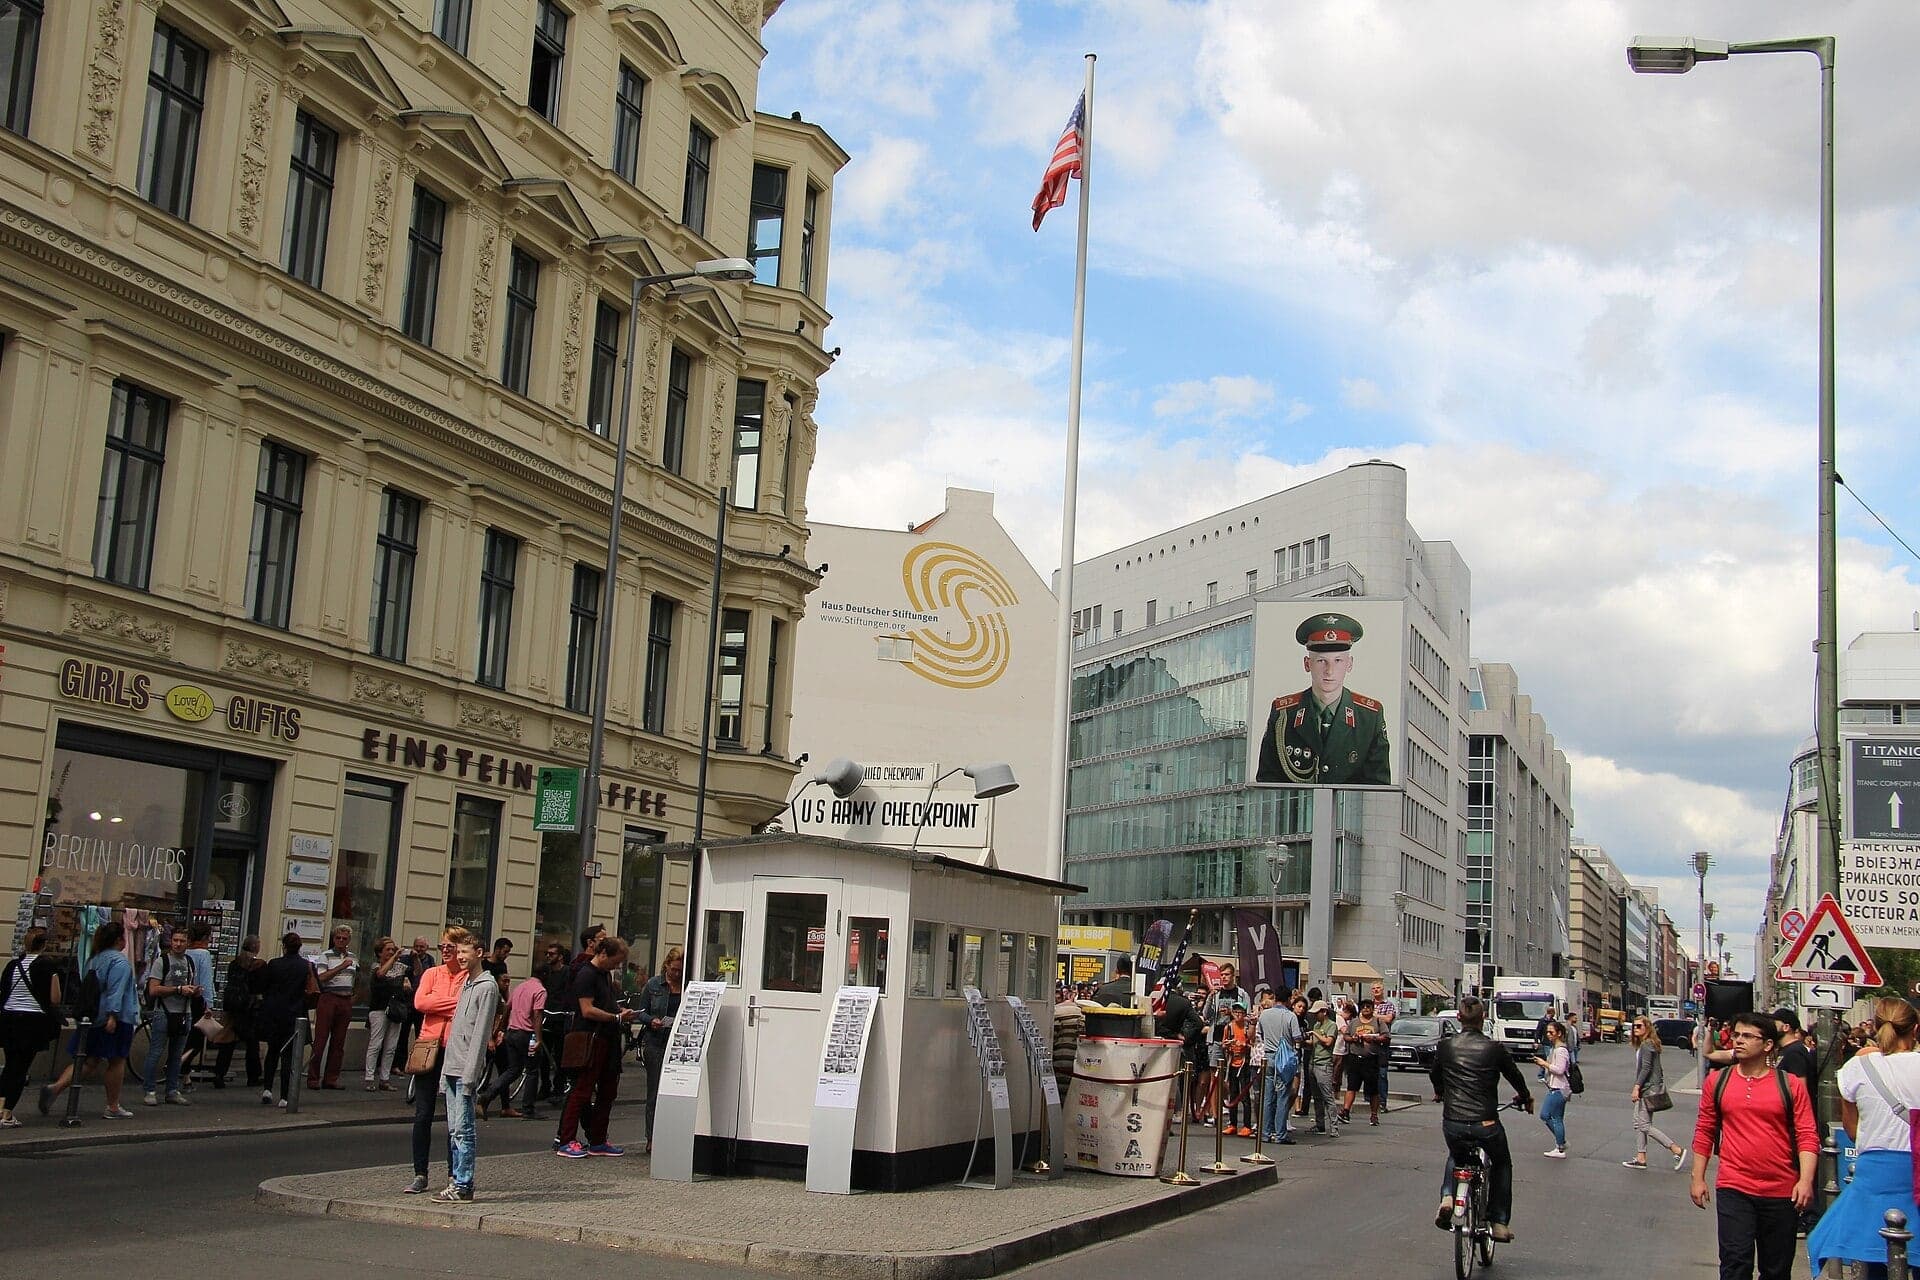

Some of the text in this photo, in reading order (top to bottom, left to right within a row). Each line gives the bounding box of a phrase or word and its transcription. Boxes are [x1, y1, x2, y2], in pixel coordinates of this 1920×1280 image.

[821, 600, 939, 623] Haus Deutscher Stiftungen
[820, 614, 906, 633] www.Stiftungen.org
[59, 658, 151, 711] GIRLS
[227, 695, 301, 742] GIFTS
[362, 728, 667, 817] EINSTEIN FFEE
[864, 766, 925, 781] LLIED CHECKPOINT
[831, 800, 876, 826] ARMY
[881, 801, 980, 829] CHECKPOINT
[43, 832, 187, 883] BERLIN LOVERS
[1846, 888, 1888, 903] VOUS
[1844, 904, 1905, 921] SECTEUR
[1876, 925, 1890, 935] DEN
[1143, 944, 1162, 960] THE
[1139, 957, 1158, 971] WALL
[1115, 1162, 1152, 1171] STAMP
